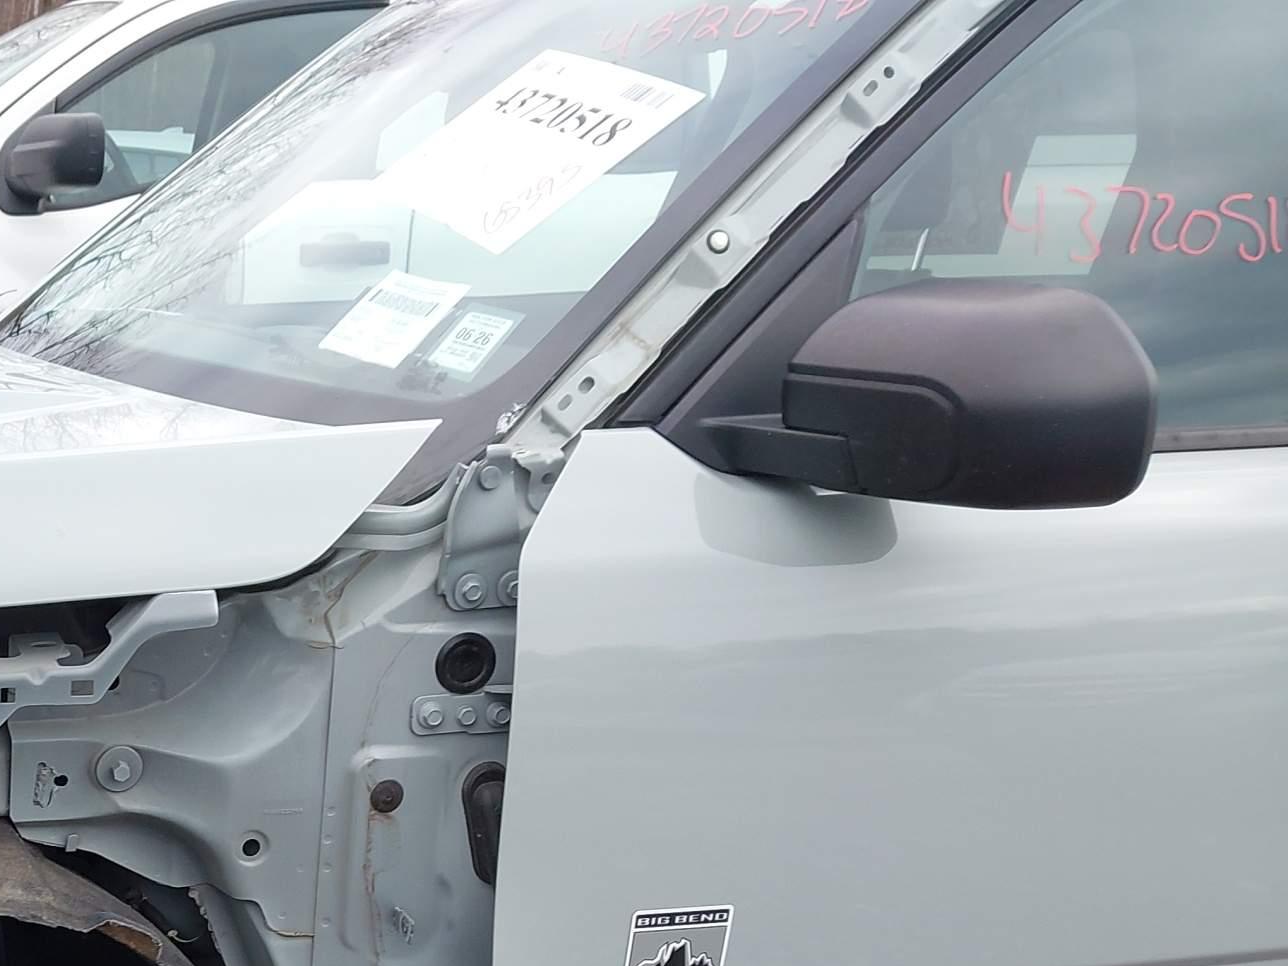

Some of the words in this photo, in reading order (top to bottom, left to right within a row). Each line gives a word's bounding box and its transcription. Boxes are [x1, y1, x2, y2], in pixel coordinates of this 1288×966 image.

[495, 86, 633, 147] 43720518
[1000, 170, 1288, 262] 4372051
[455, 326, 473, 342] 06
[473, 330, 495, 347] 26
[636, 915, 672, 927] BIG
[674, 911, 729, 924] BEND
